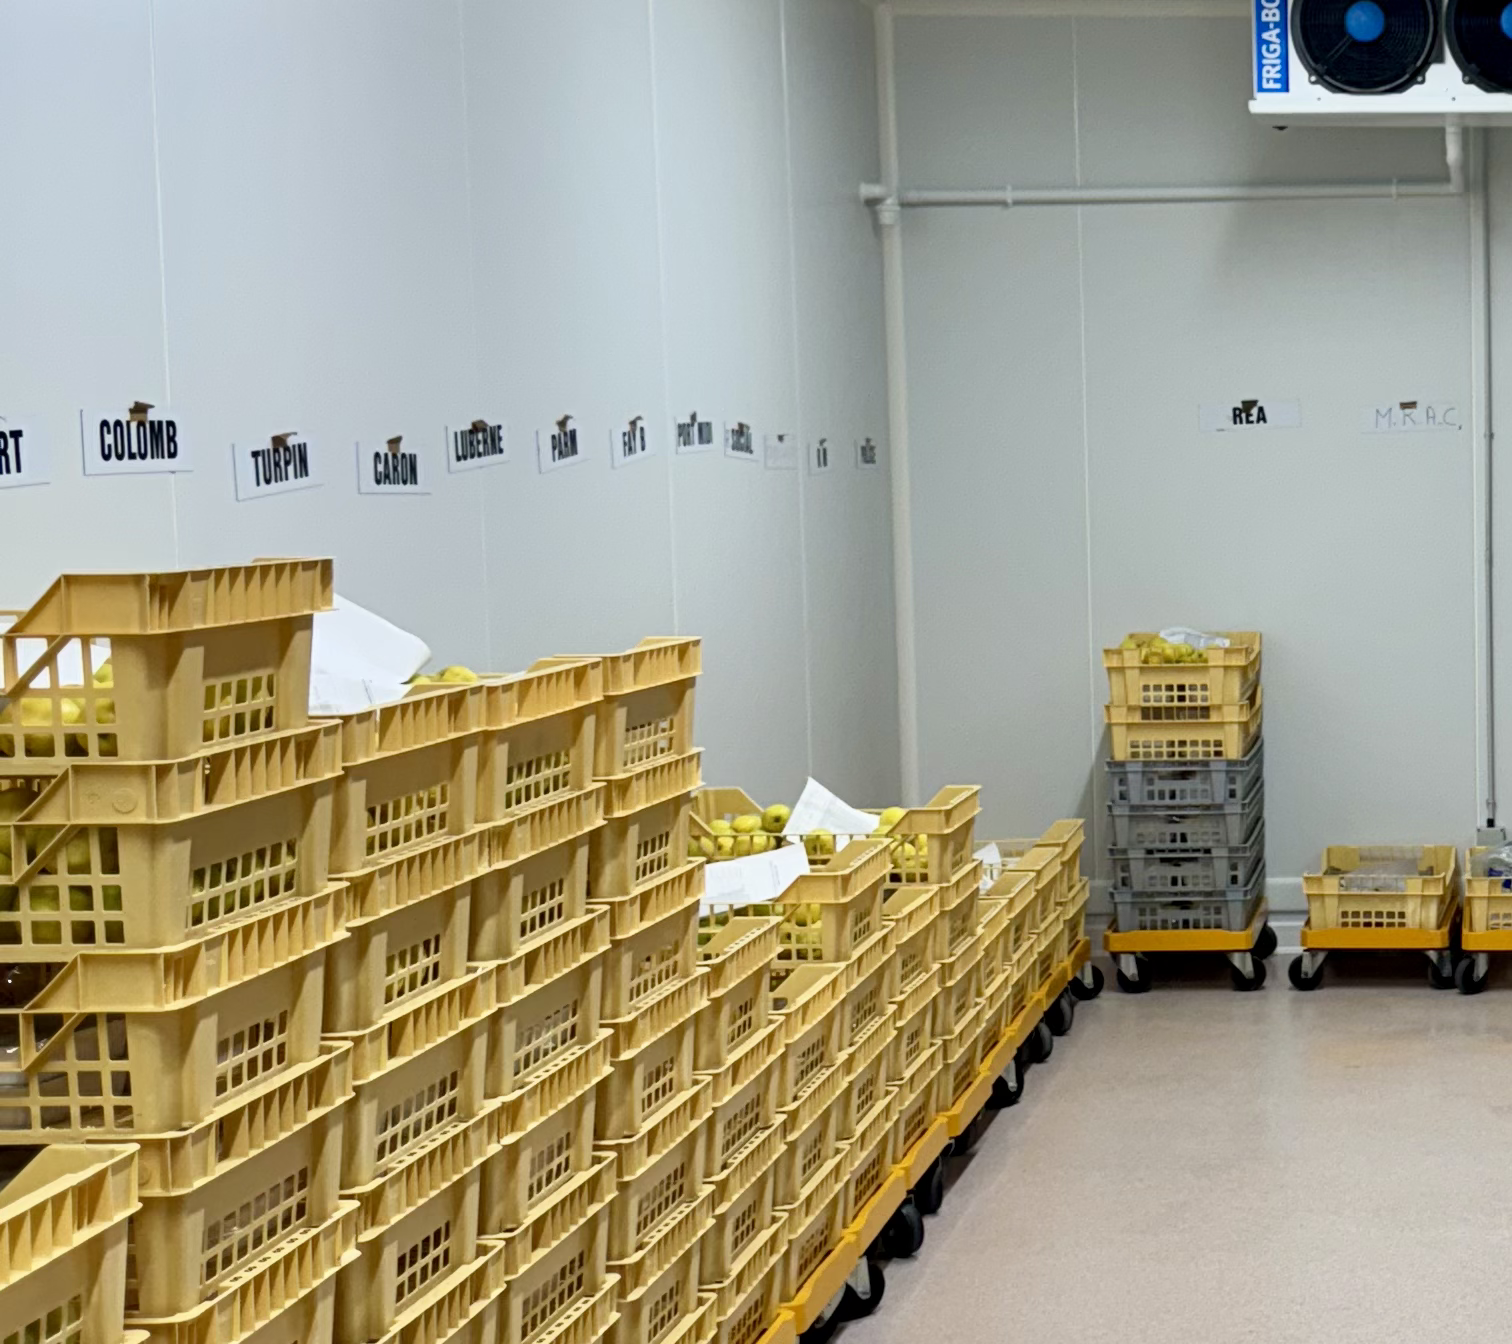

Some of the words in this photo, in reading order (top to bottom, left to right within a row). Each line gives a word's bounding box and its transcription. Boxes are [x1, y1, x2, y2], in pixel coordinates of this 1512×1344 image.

[1232, 406, 1267, 425] REA
[100, 419, 178, 461] COLOMB
[251, 444, 309, 486] TURPIN
[373, 452, 418, 487] CARON
